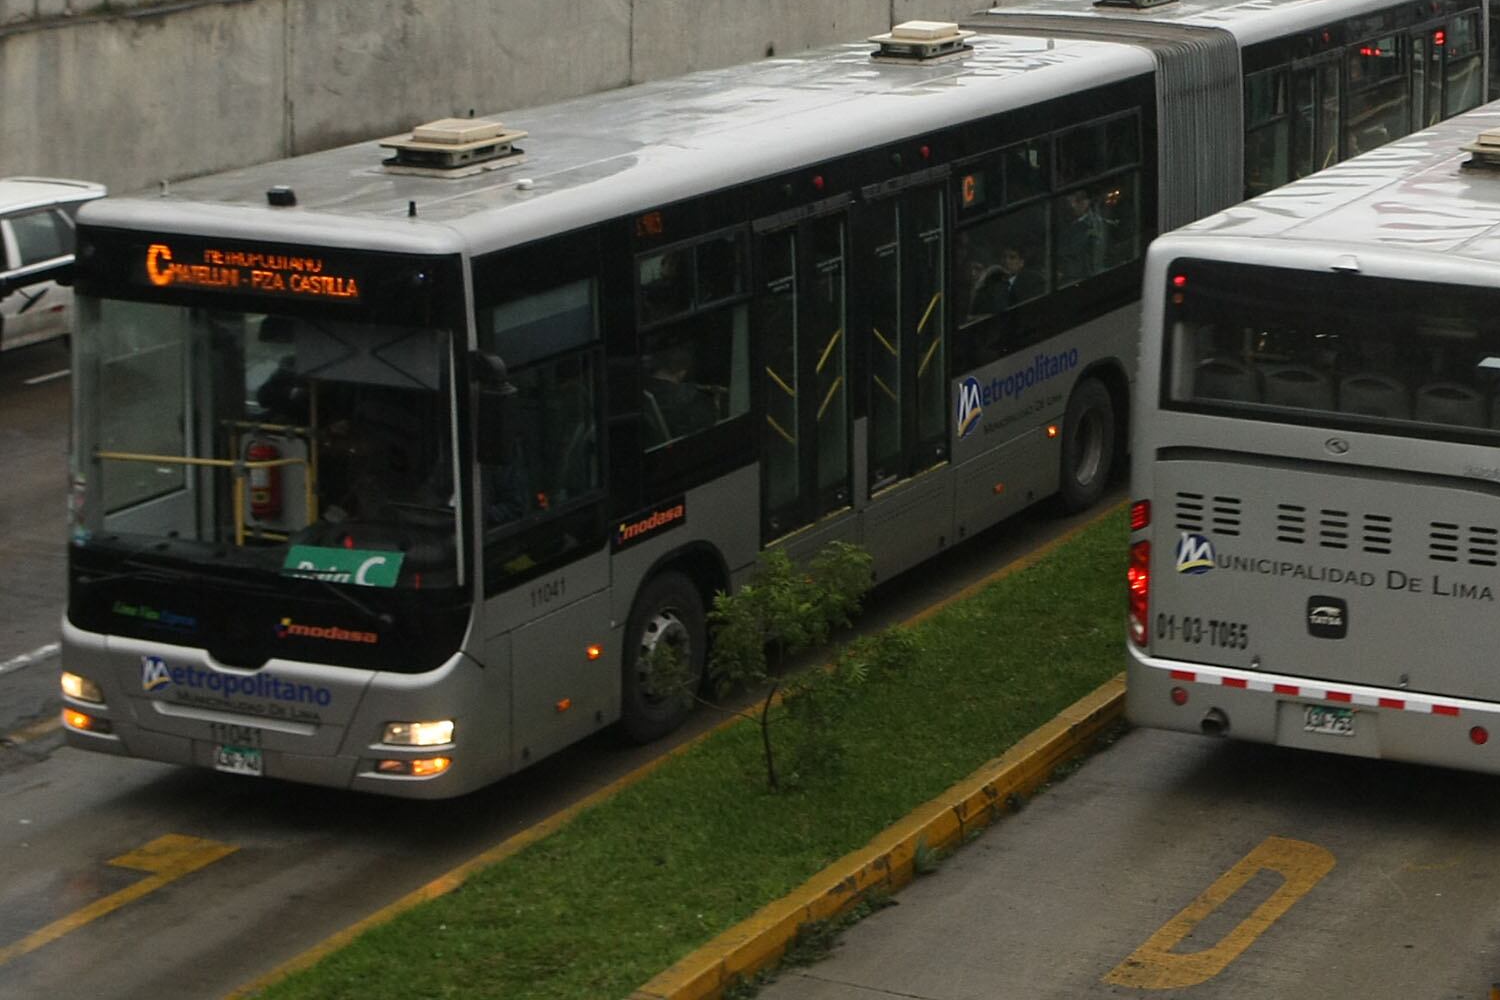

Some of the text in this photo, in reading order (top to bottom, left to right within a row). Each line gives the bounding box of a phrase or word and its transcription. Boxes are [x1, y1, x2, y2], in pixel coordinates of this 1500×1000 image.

[146, 244, 173, 286] C
[204, 249, 323, 273] METROPOLITANO
[290, 273, 358, 298] CASTILLA
[958, 347, 1078, 438] Metropolitano
[624, 505, 684, 540] modasa
[530, 576, 566, 608] 11041
[288, 622, 378, 644] modasa
[1156, 613, 1249, 650] 01-03-T055
[141, 656, 332, 706] Metropolitano
[209, 722, 263, 745] 11041
